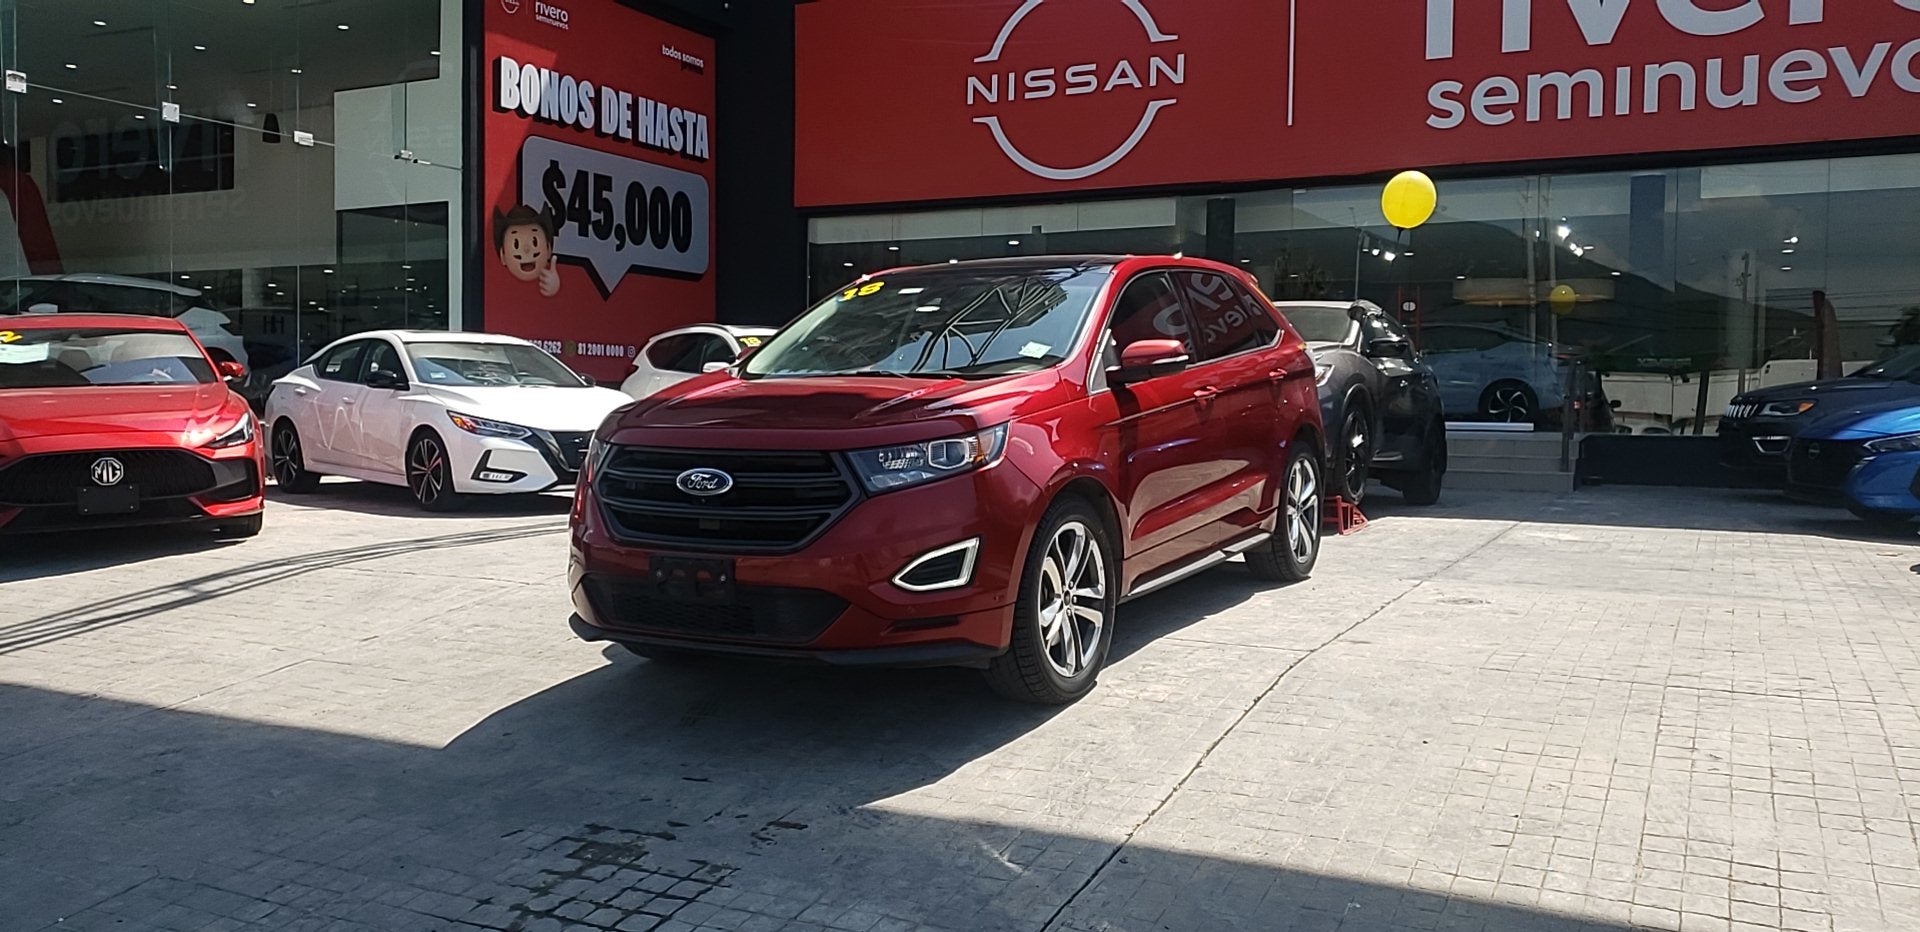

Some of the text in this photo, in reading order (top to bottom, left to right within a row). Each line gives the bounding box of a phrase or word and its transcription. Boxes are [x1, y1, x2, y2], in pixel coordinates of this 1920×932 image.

[535, 1, 569, 22] rivero
[662, 44, 704, 68] todos somos
[966, 53, 1185, 105] NISSAN
[500, 55, 710, 160] BONOS DE HASTA
[542, 159, 693, 253] $45,000
[577, 342, 586, 356] 81
[587, 342, 605, 357] 2001
[94, 460, 121, 483] MG
[687, 472, 719, 489] Ford
